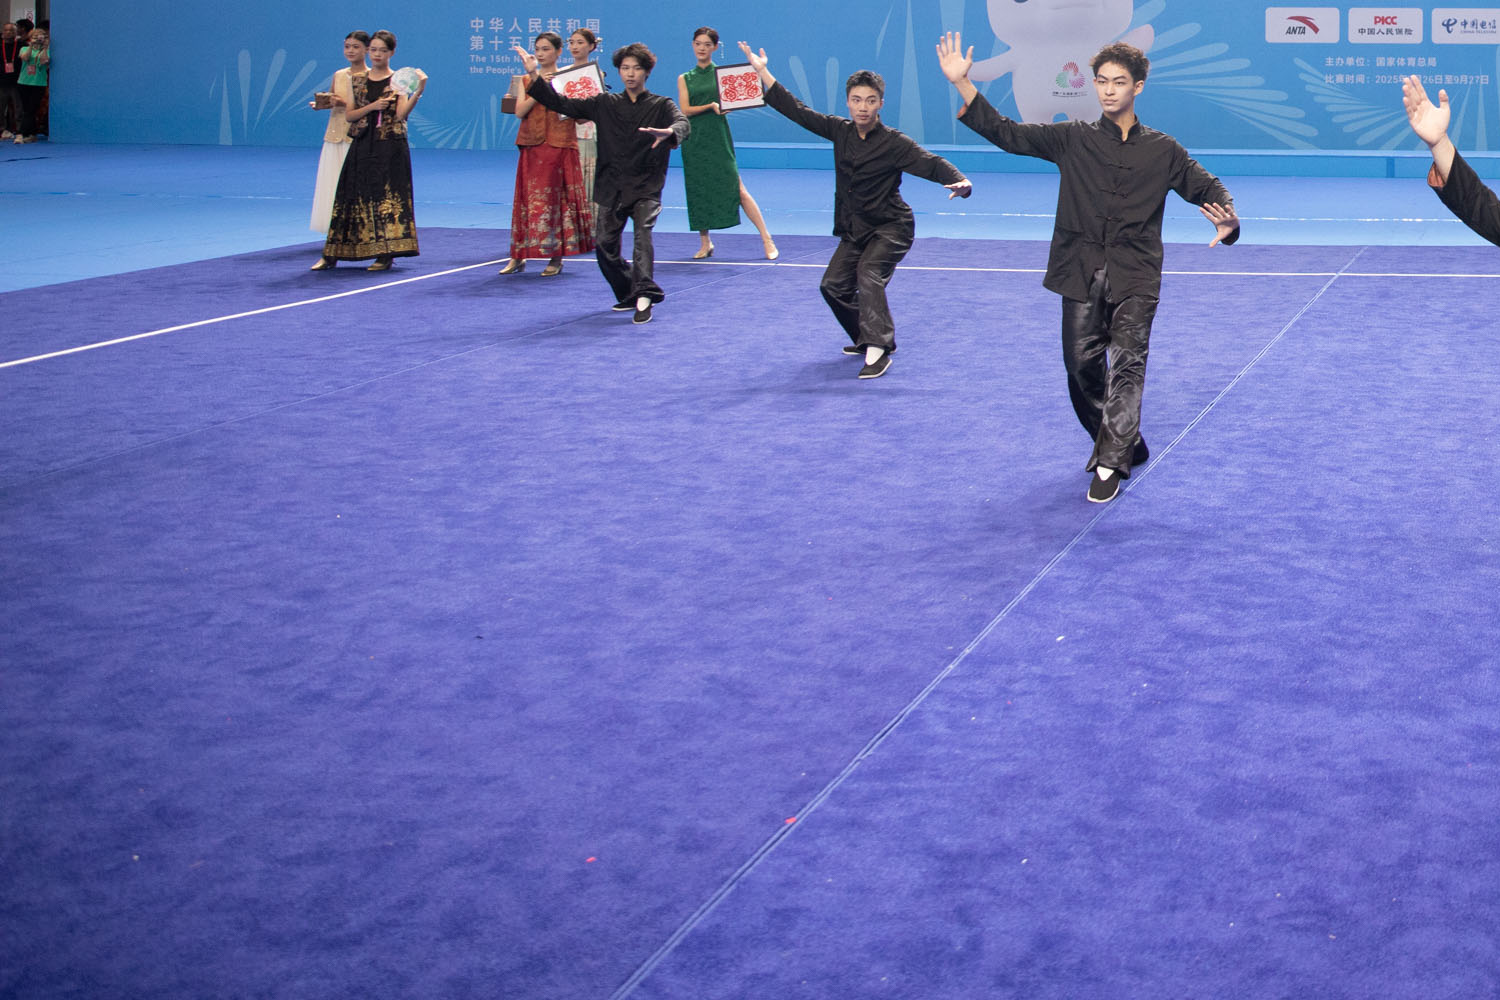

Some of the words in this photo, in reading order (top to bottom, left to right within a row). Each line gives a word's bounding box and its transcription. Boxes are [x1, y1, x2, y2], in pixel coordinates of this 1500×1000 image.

[1374, 16, 1397, 25] PICC
[1460, 18, 1497, 29] 中国电信
[1285, 26, 1306, 35] ANTA
[1358, 28, 1413, 36] 中国人民保险
[470, 66, 483, 74] the
[486, 66, 522, 75] People's
